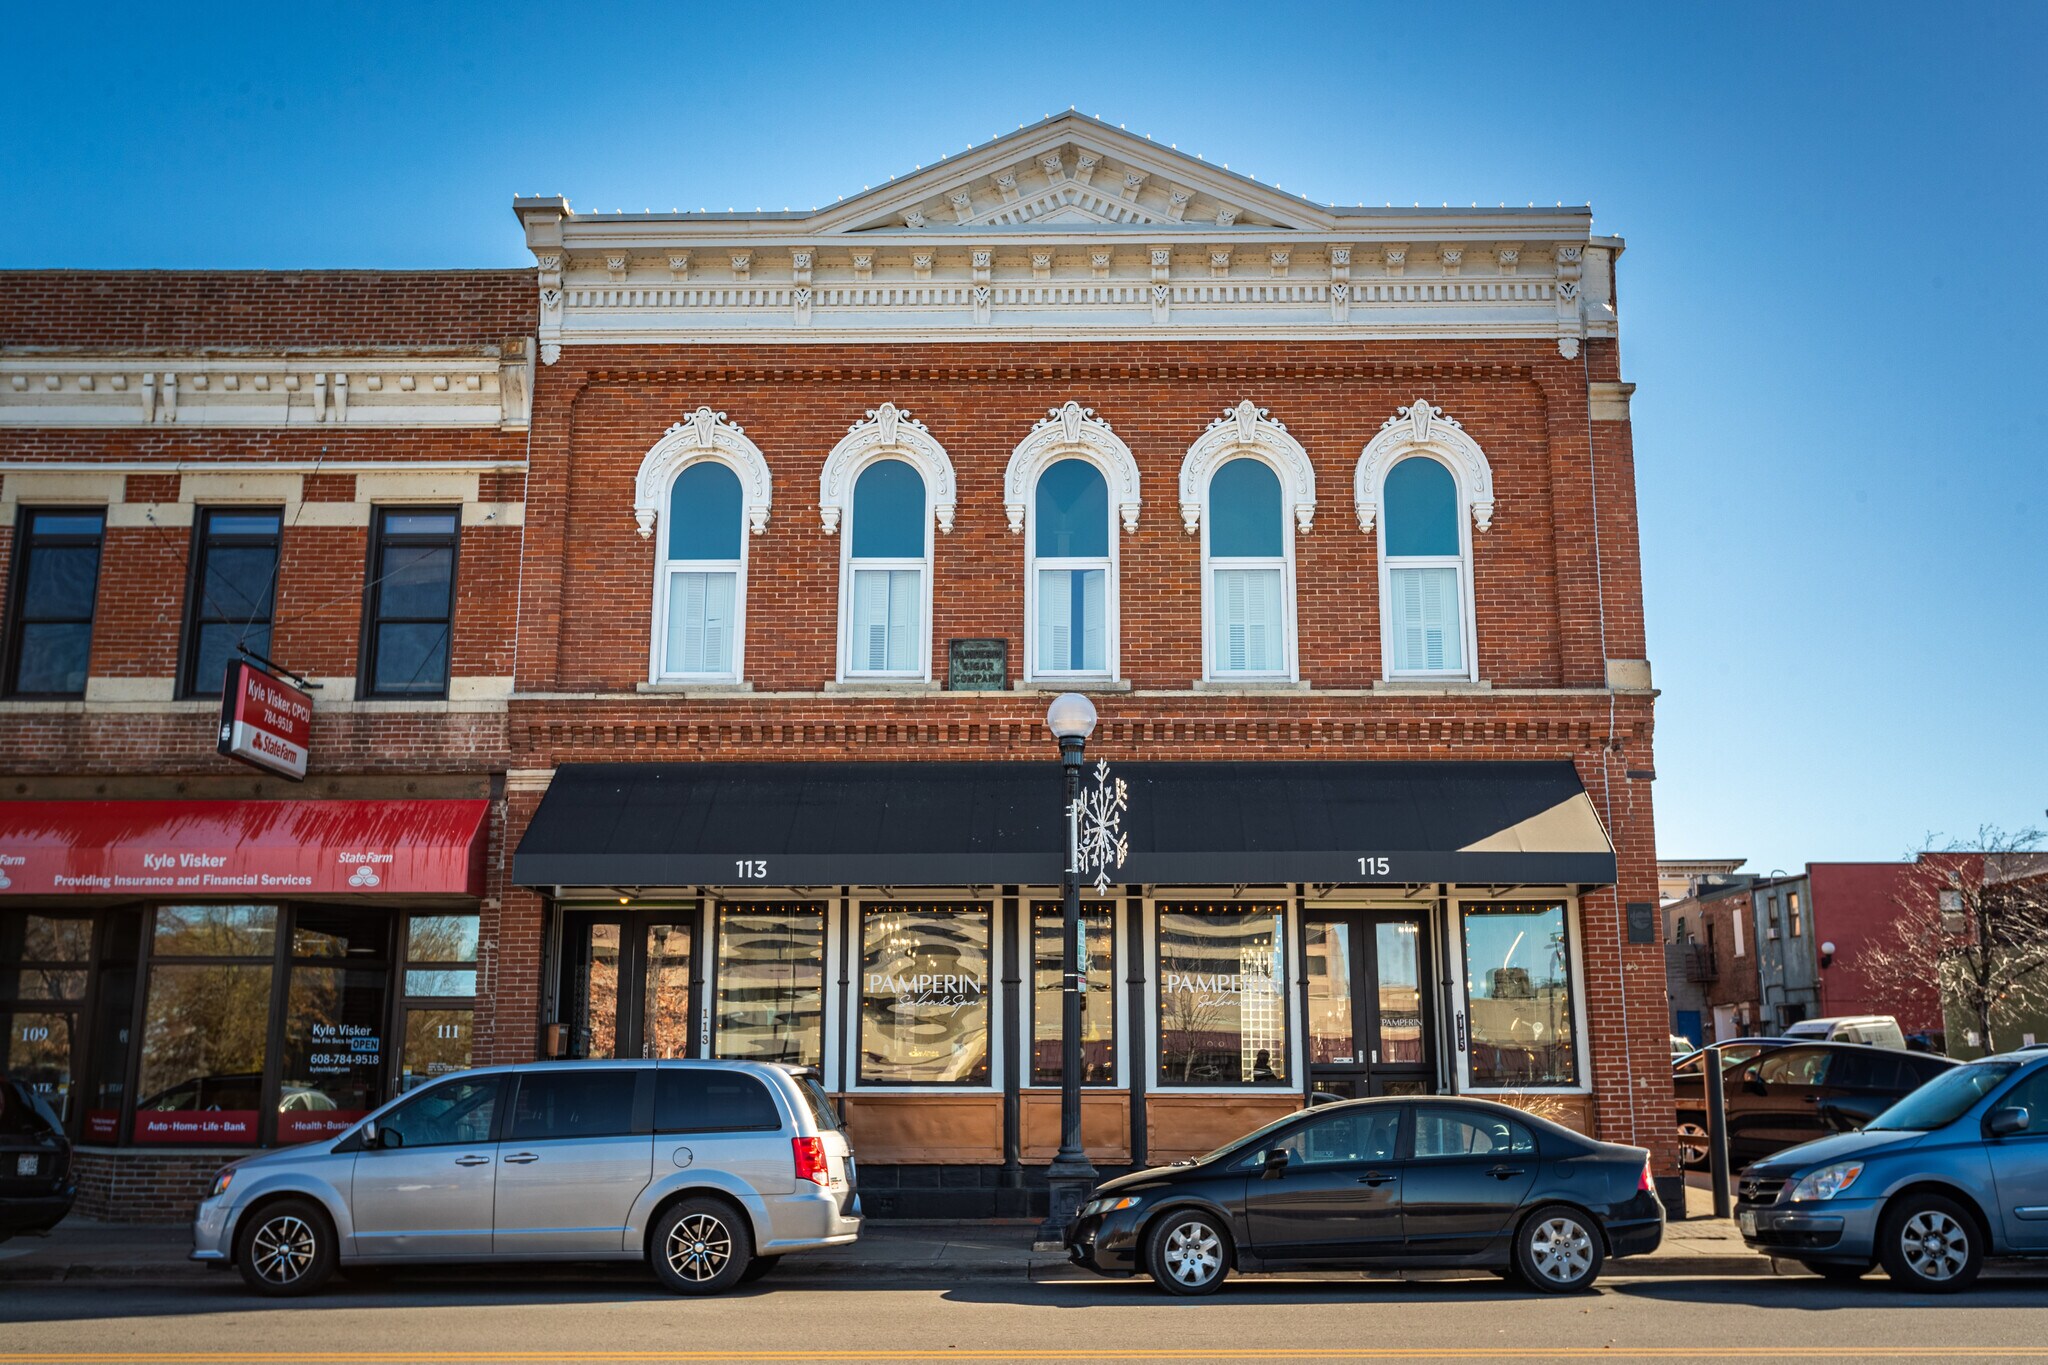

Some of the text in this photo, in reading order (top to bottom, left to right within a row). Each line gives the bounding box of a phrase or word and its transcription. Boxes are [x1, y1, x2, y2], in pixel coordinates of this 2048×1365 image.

[953, 673, 1003, 683] COMPANY
[248, 679, 265, 701] Kyle
[292, 702, 311, 723] CPCU
[264, 709, 293, 733] 784-9518
[143, 853, 227, 871] Kyle Visker
[735, 860, 767, 879] 113
[1357, 857, 1390, 876] 115
[54, 874, 312, 888] Providing Insurance and Financial Services
[869, 974, 981, 994] PAMPERIN
[1168, 974, 1280, 994] PAMPERIN
[1382, 1018, 1423, 1027] PAMPERIN
[22, 1026, 48, 1042] 109
[312, 1024, 372, 1037] Kyle Visker
[437, 1024, 459, 1039] 111
[353, 1039, 378, 1049] OPEN
[310, 1054, 379, 1065] 608-784-9518
[148, 1121, 246, 1131] Auto Home Life Bank
[295, 1121, 322, 1130] Health
